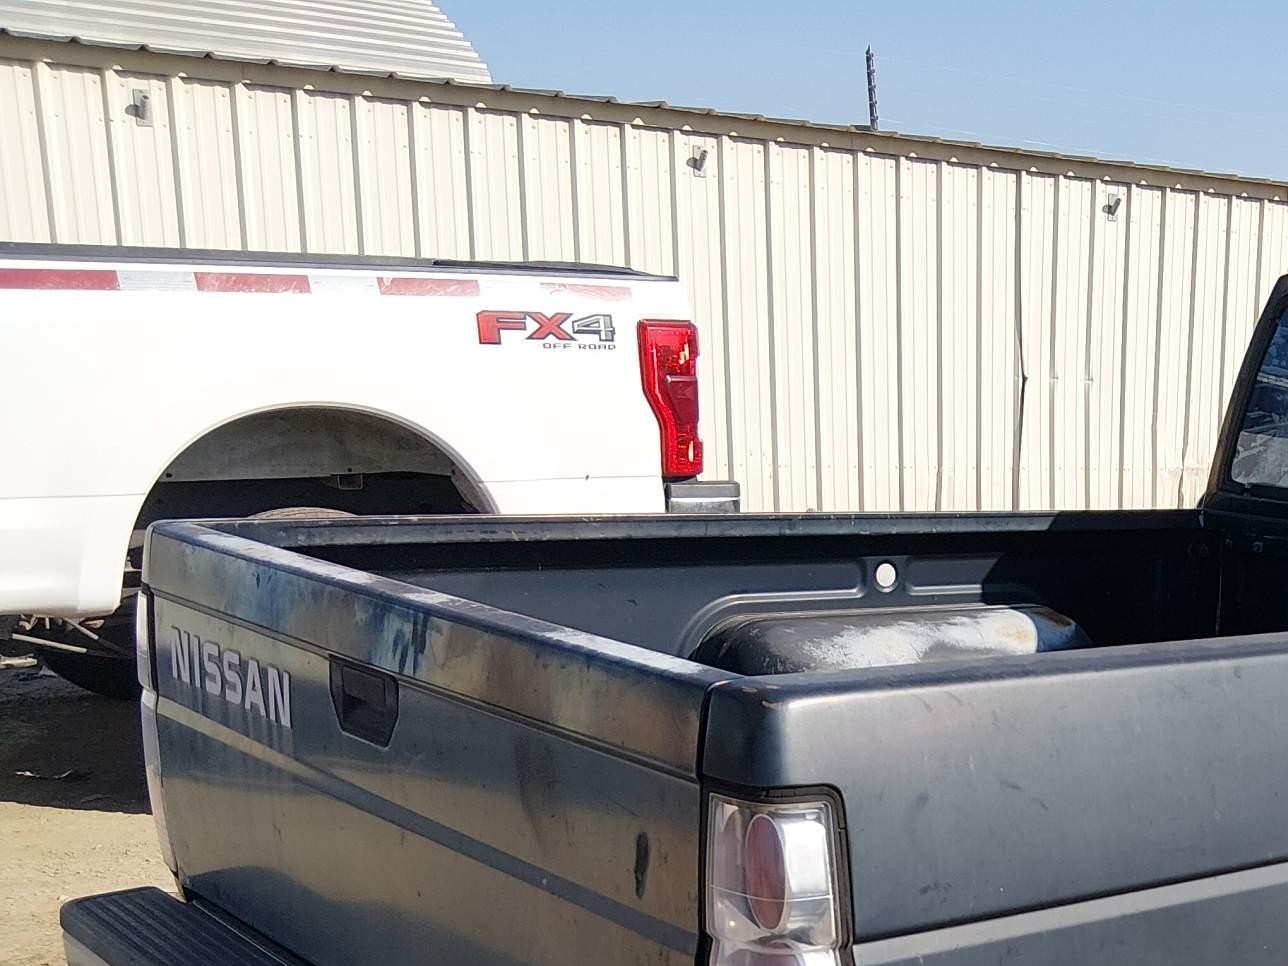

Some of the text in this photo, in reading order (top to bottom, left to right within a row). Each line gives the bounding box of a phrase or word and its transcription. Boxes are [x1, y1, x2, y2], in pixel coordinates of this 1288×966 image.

[476, 310, 616, 345] FX4
[543, 342, 572, 350] OFF
[170, 626, 292, 728] NISSAN
